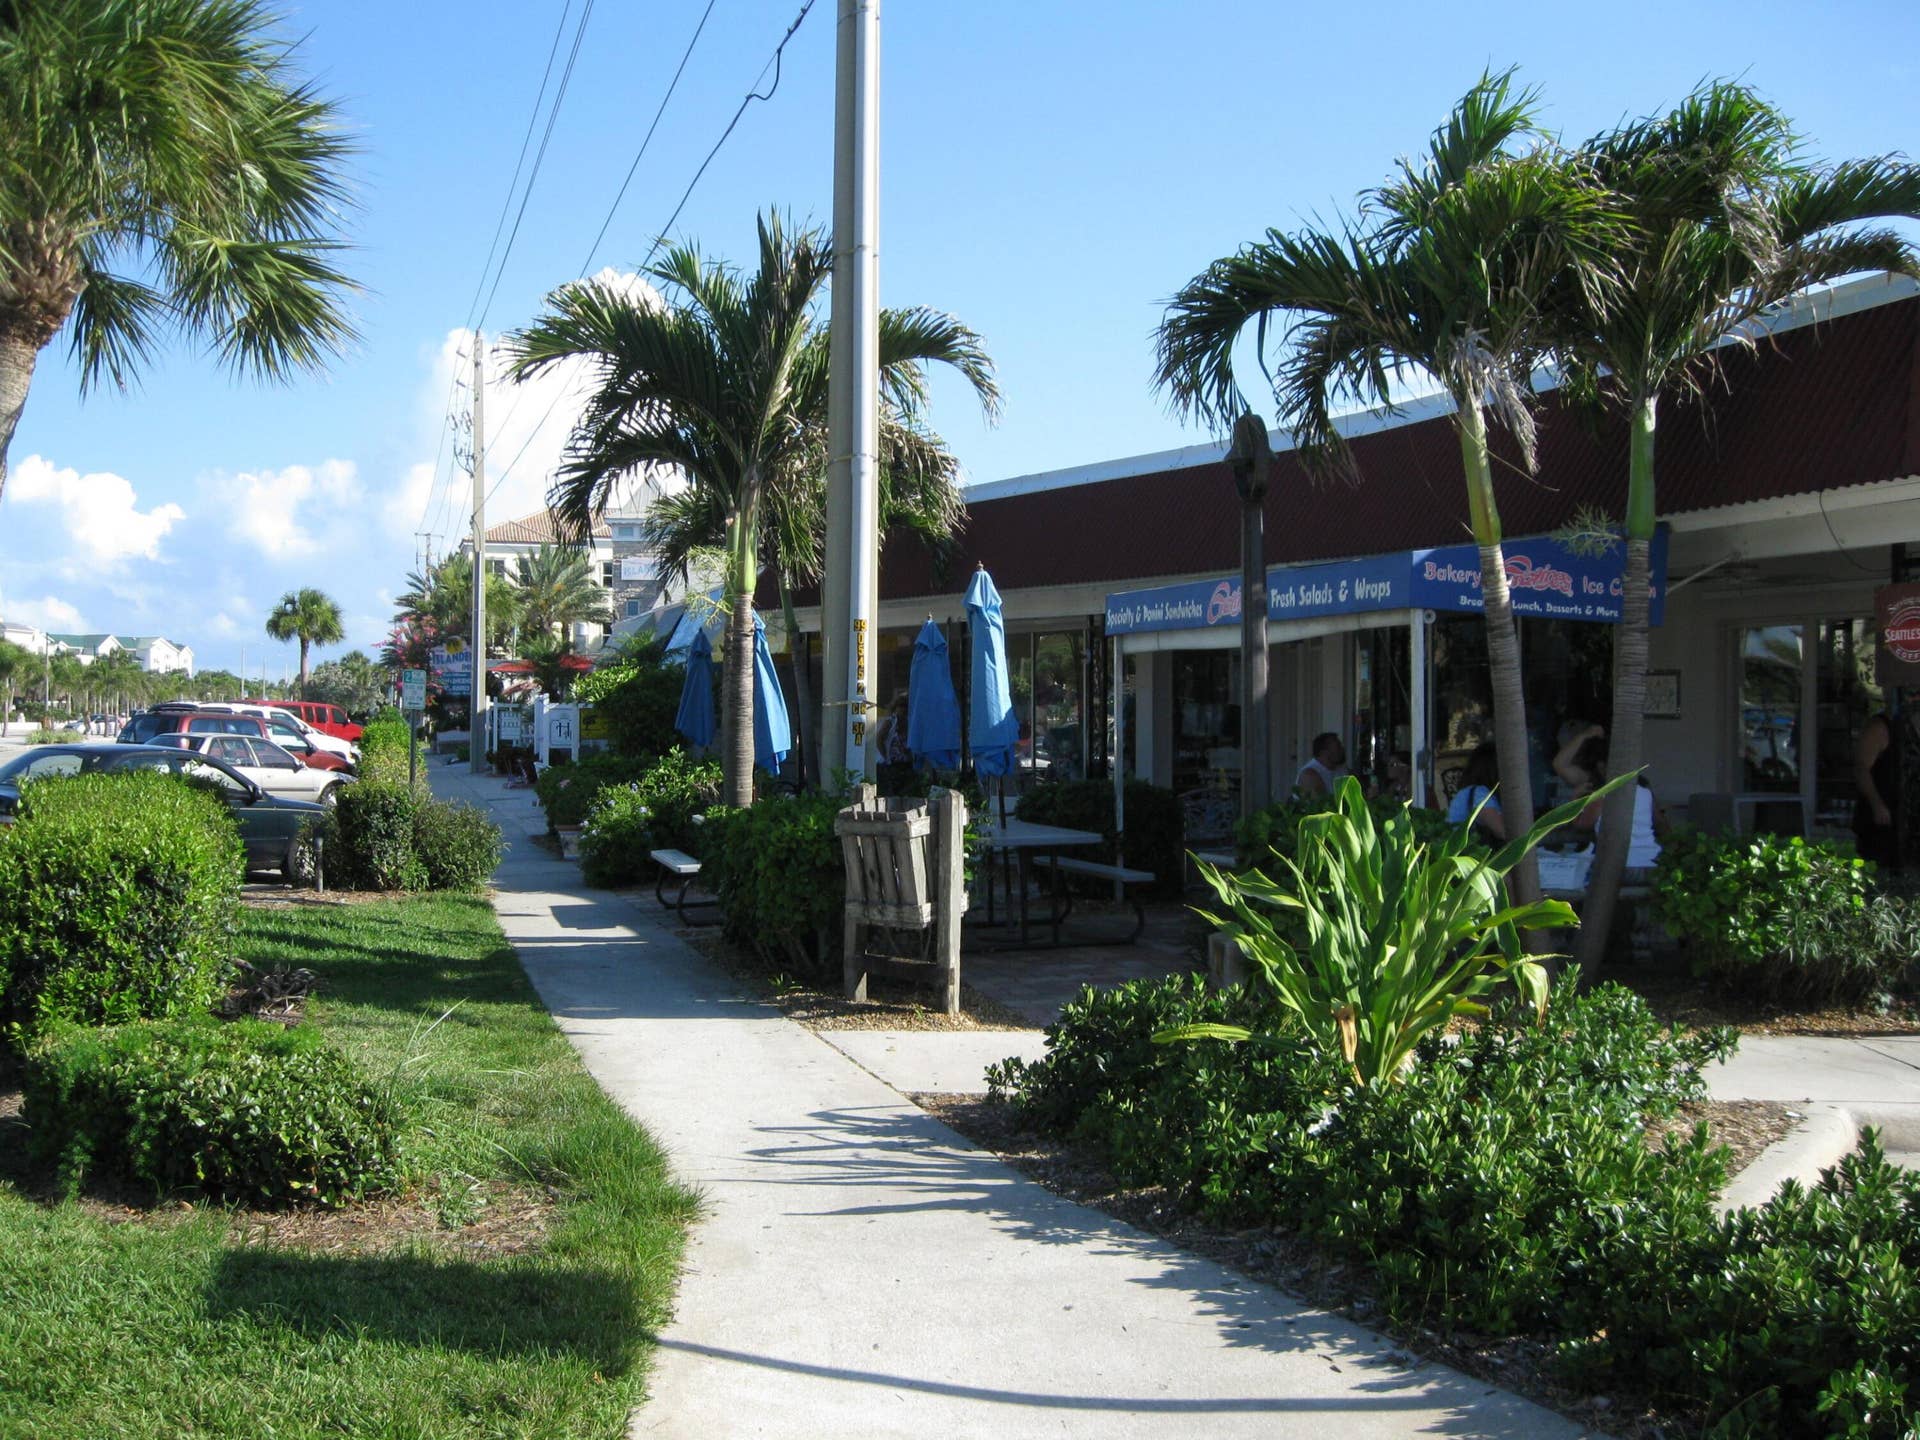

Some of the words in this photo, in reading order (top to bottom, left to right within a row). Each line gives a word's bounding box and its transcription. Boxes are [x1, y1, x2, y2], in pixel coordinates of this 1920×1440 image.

[1423, 561, 1482, 588] Bakery
[1582, 575, 1605, 595] Ice
[1106, 607, 1134, 629] Specialty
[1135, 605, 1141, 623] &
[1143, 600, 1164, 622] Panini
[1165, 598, 1203, 620] Sandwiches
[1270, 585, 1296, 608] Fresh
[1298, 582, 1333, 606] Salads
[1339, 579, 1348, 602] &
[1354, 577, 1391, 602] Wraps
[1512, 600, 1543, 613] Lunch,
[1546, 601, 1582, 615] Desserts
[1585, 605, 1593, 615] &
[1596, 606, 1619, 617] More
